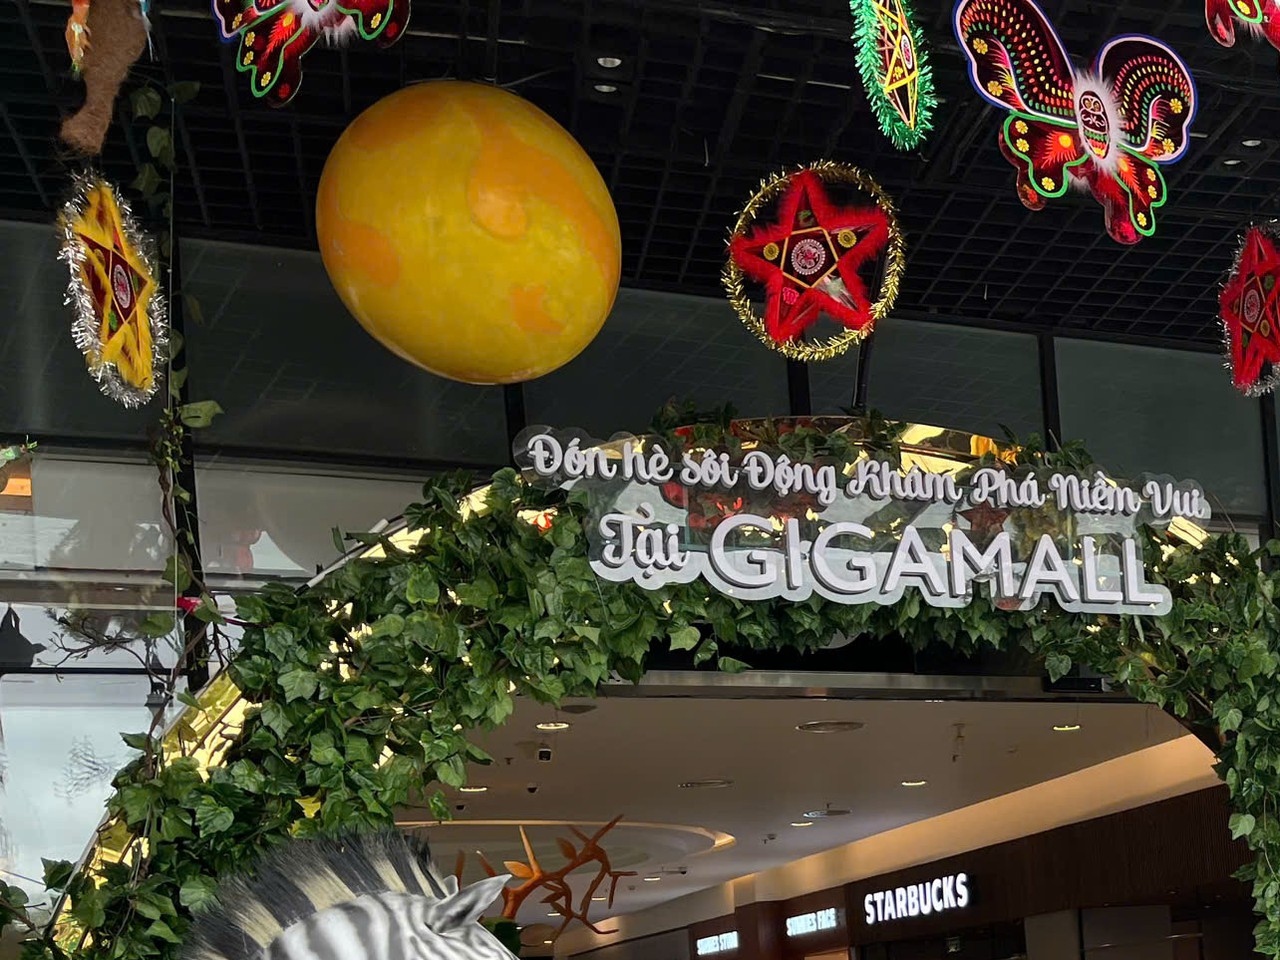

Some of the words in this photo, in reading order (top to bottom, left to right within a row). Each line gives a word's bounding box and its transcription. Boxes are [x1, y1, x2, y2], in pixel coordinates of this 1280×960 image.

[527, 434, 617, 479] Đón
[622, 439, 675, 483] hè
[680, 449, 740, 488] sôi
[743, 451, 838, 506] Động
[846, 459, 963, 502] Khám
[969, 468, 1048, 507] Phá
[1050, 470, 1143, 516] Niềm
[1145, 480, 1206, 518] Vui
[600, 502, 691, 579] Tại
[710, 513, 1165, 605] GIGAMALL
[864, 872, 969, 925] STARBUCKS
